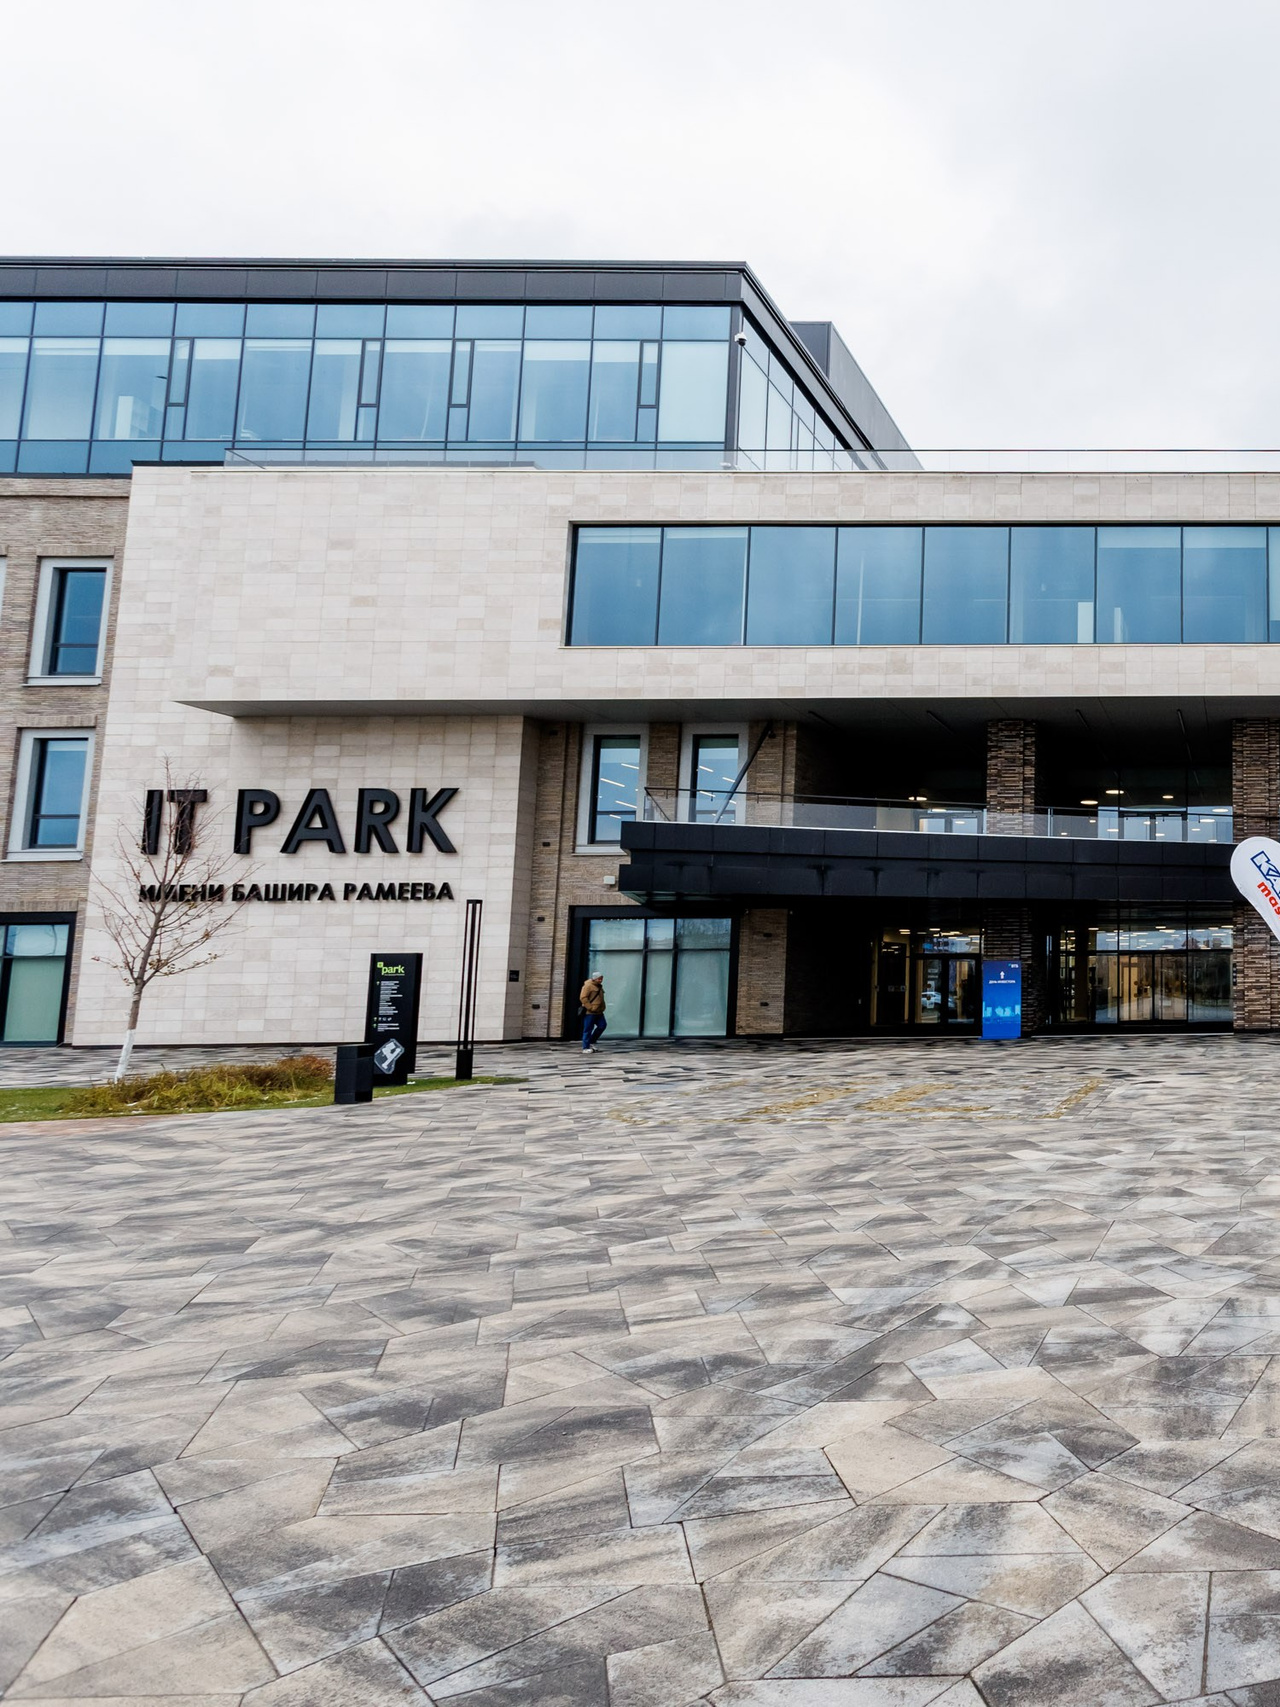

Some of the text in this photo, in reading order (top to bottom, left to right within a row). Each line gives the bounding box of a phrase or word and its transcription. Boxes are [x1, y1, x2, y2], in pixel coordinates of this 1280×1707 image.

[141, 788, 460, 855] IT PARK
[138, 882, 454, 902] ИМЕНИ БАШИРА РАМЕЕВА
